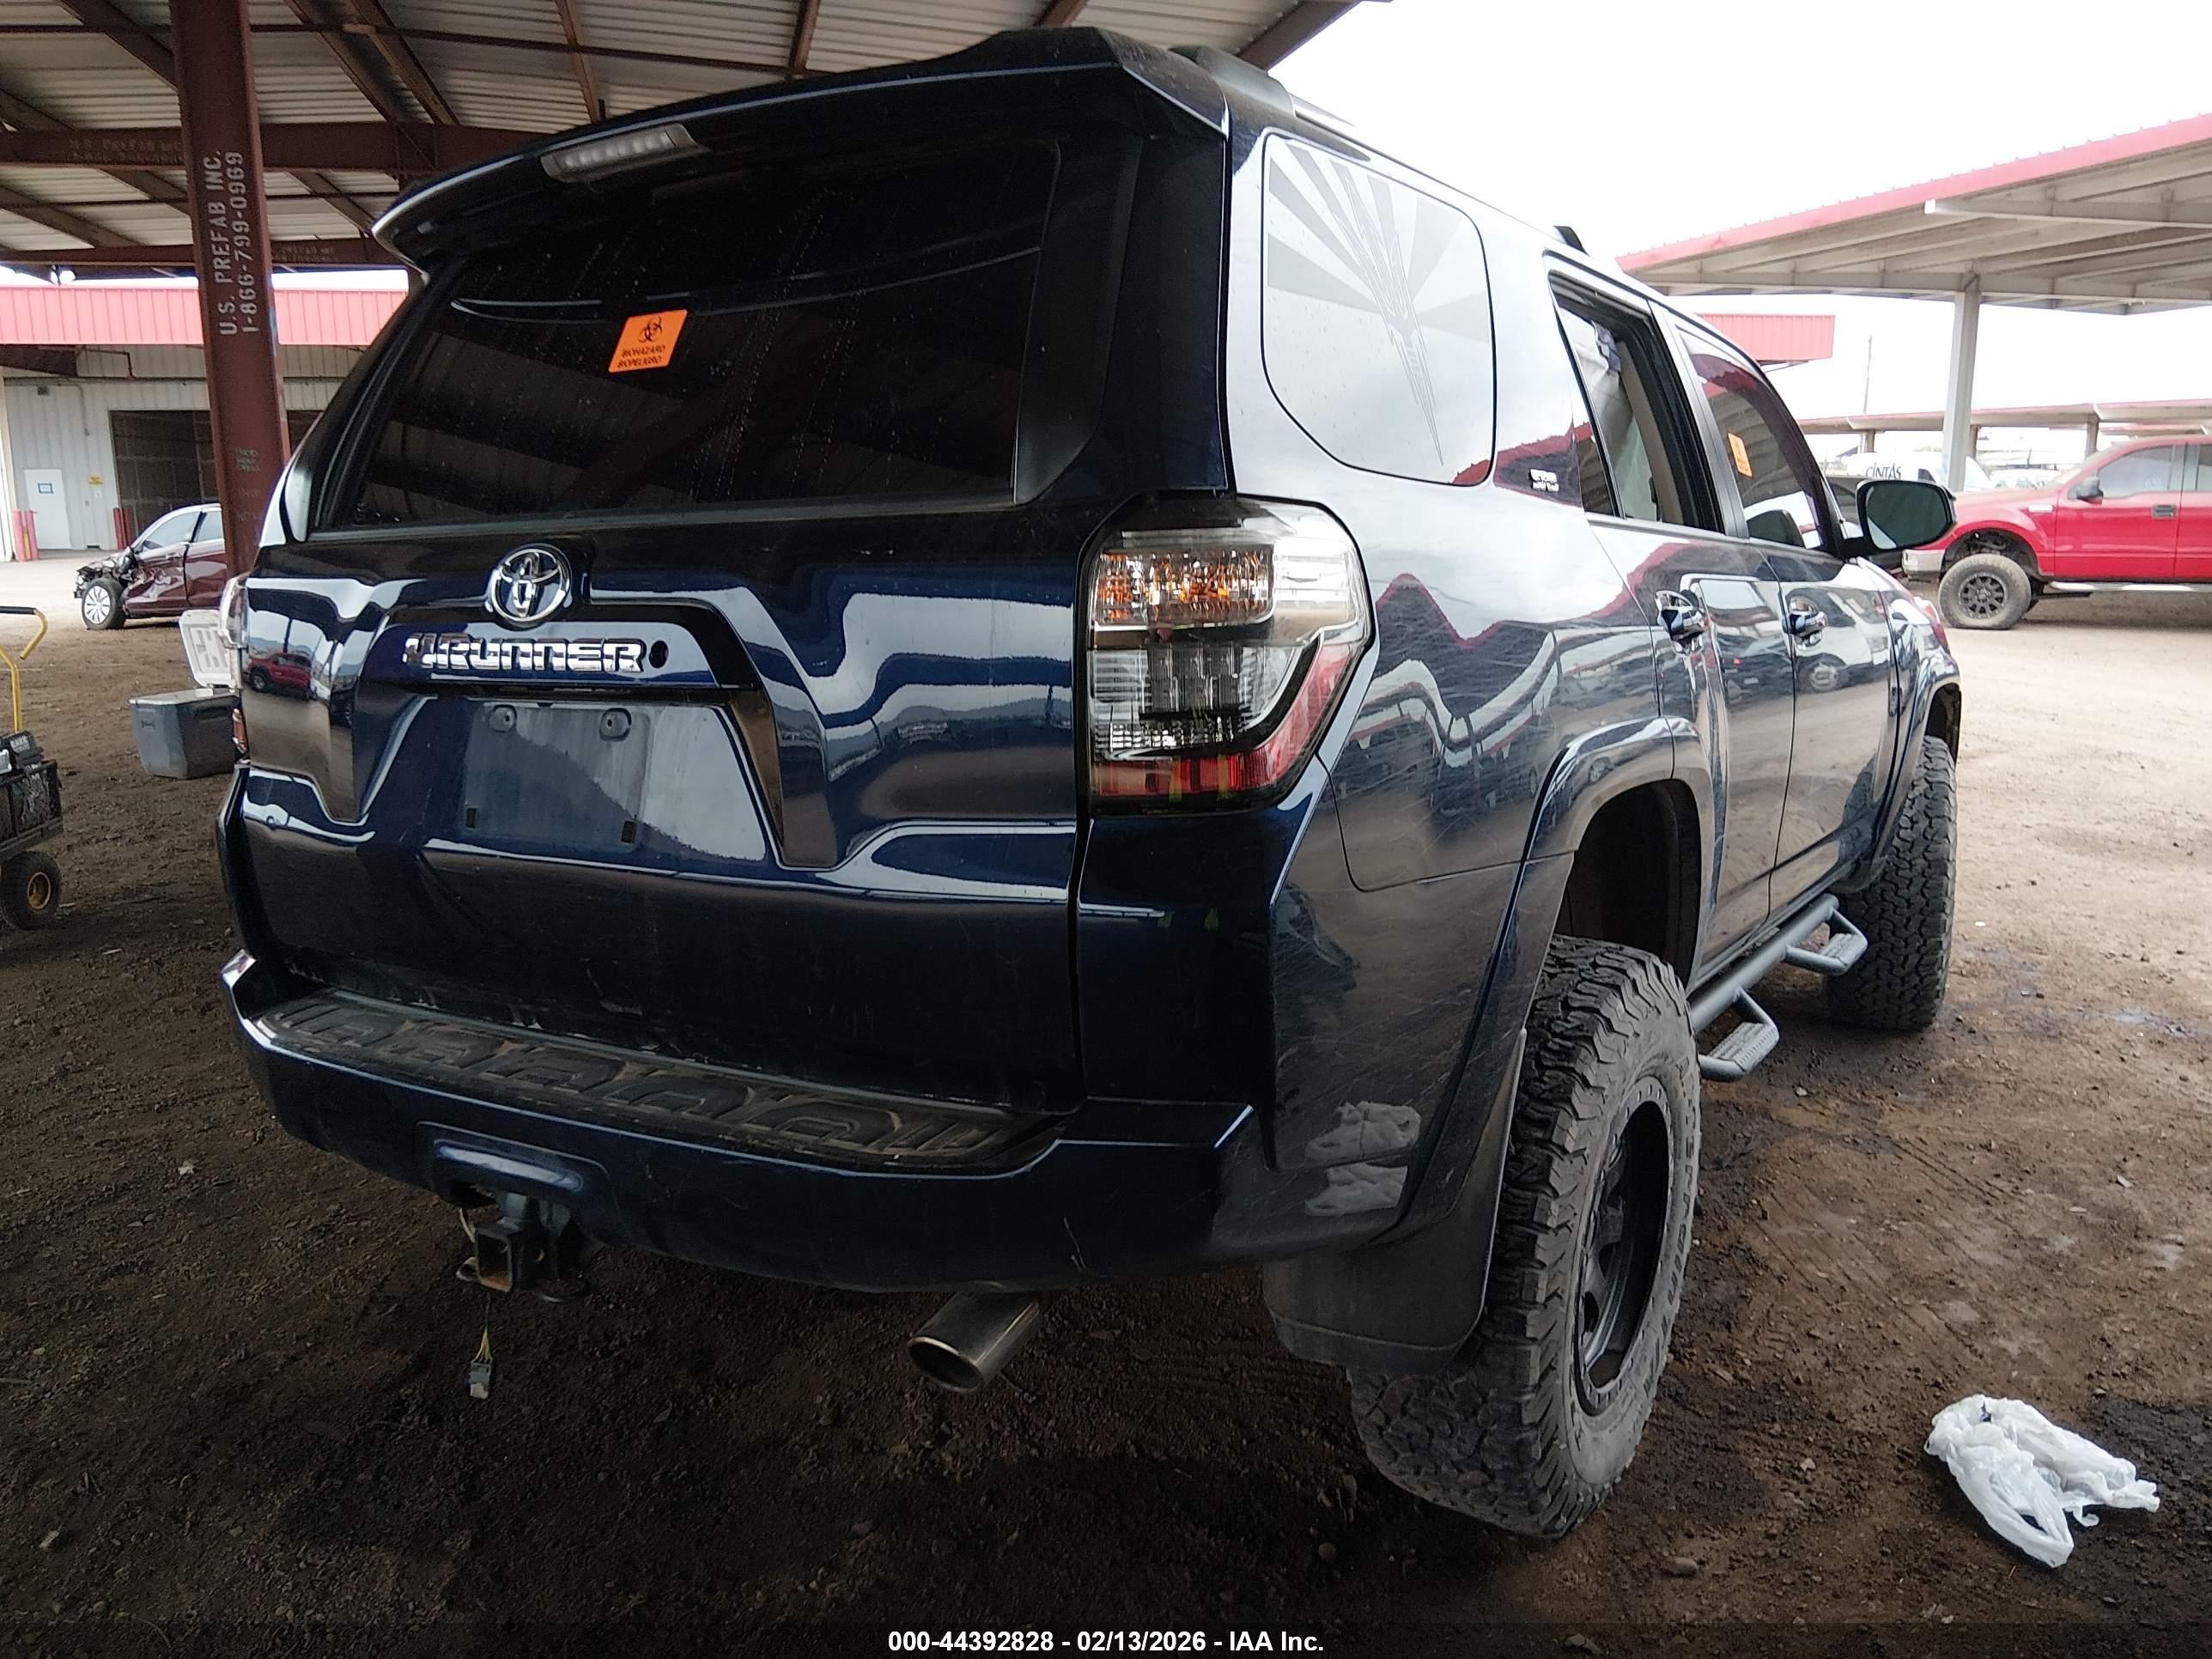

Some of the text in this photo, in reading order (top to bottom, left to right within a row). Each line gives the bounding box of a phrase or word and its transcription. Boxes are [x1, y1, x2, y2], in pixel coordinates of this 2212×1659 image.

[203, 150, 238, 336] U.S. PREFAB INC.
[224, 152, 258, 333] 1-866-799-0969
